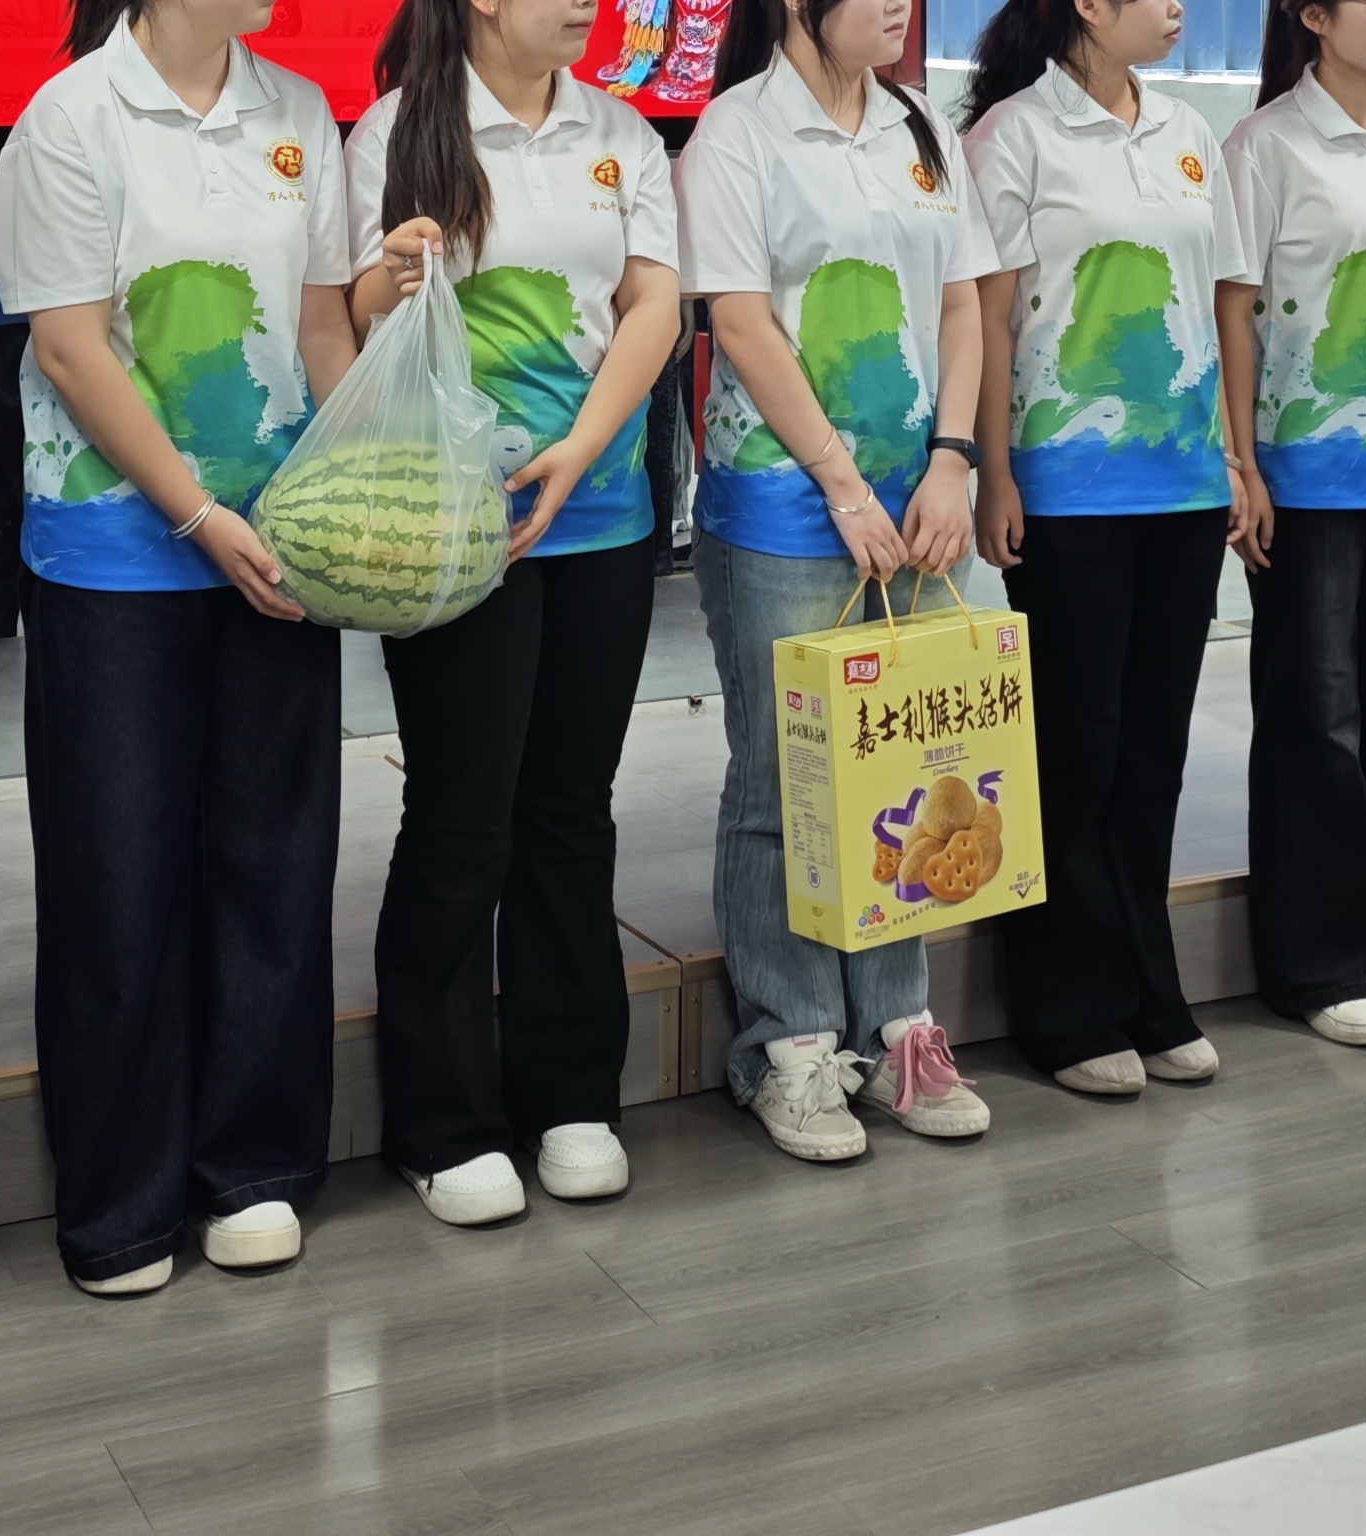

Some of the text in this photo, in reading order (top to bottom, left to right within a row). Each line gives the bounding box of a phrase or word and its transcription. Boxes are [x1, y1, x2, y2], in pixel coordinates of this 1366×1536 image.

[849, 667, 1024, 761] 嘉士利猴头菇饼
